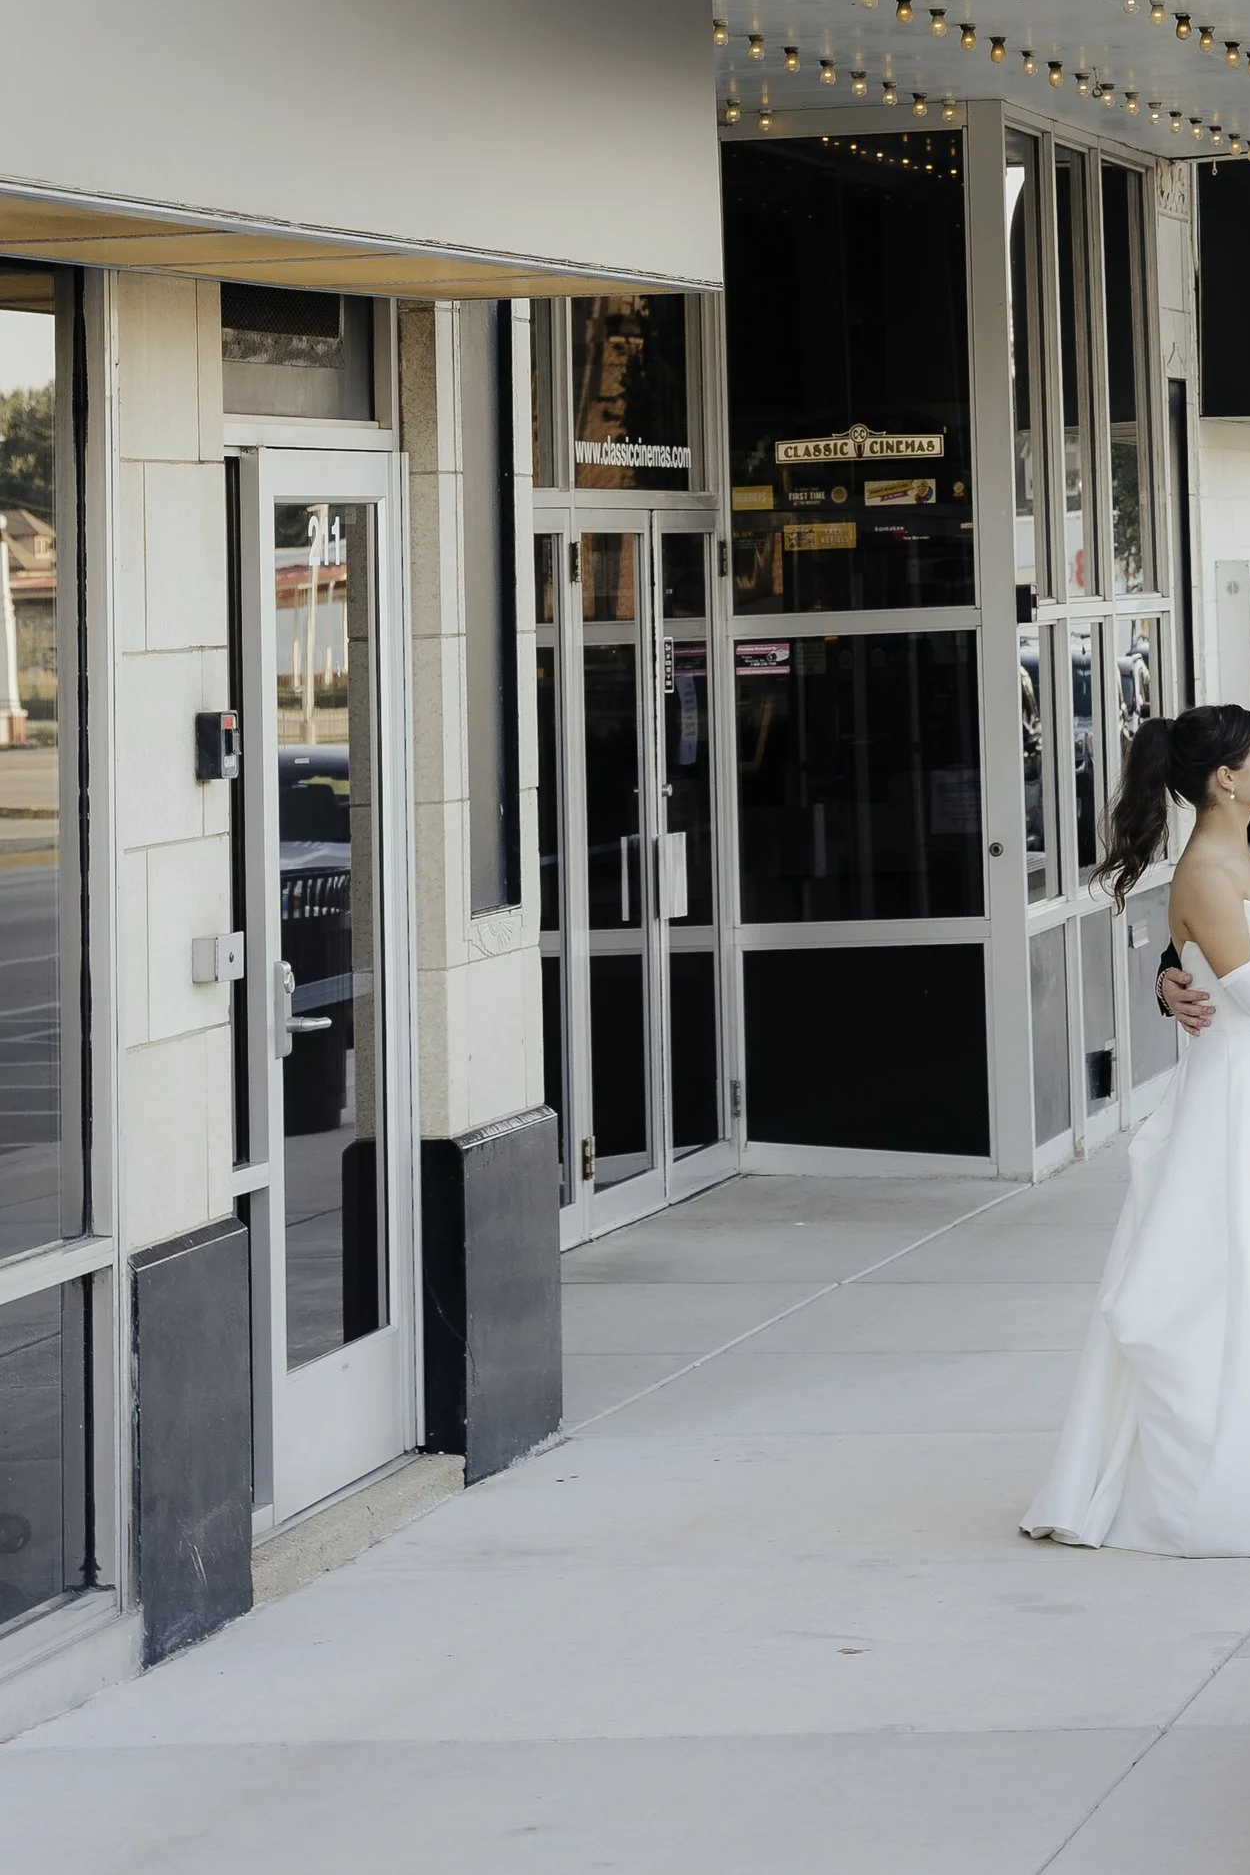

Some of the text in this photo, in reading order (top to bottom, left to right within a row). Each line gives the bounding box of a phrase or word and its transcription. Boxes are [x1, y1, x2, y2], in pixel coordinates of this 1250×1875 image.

[575, 435, 691, 468] www.classiccinemas.com
[783, 440, 935, 459] CLASSIC CINEMAS
[788, 491, 825, 501] FIRST TIME
[308, 515, 340, 567] 211
